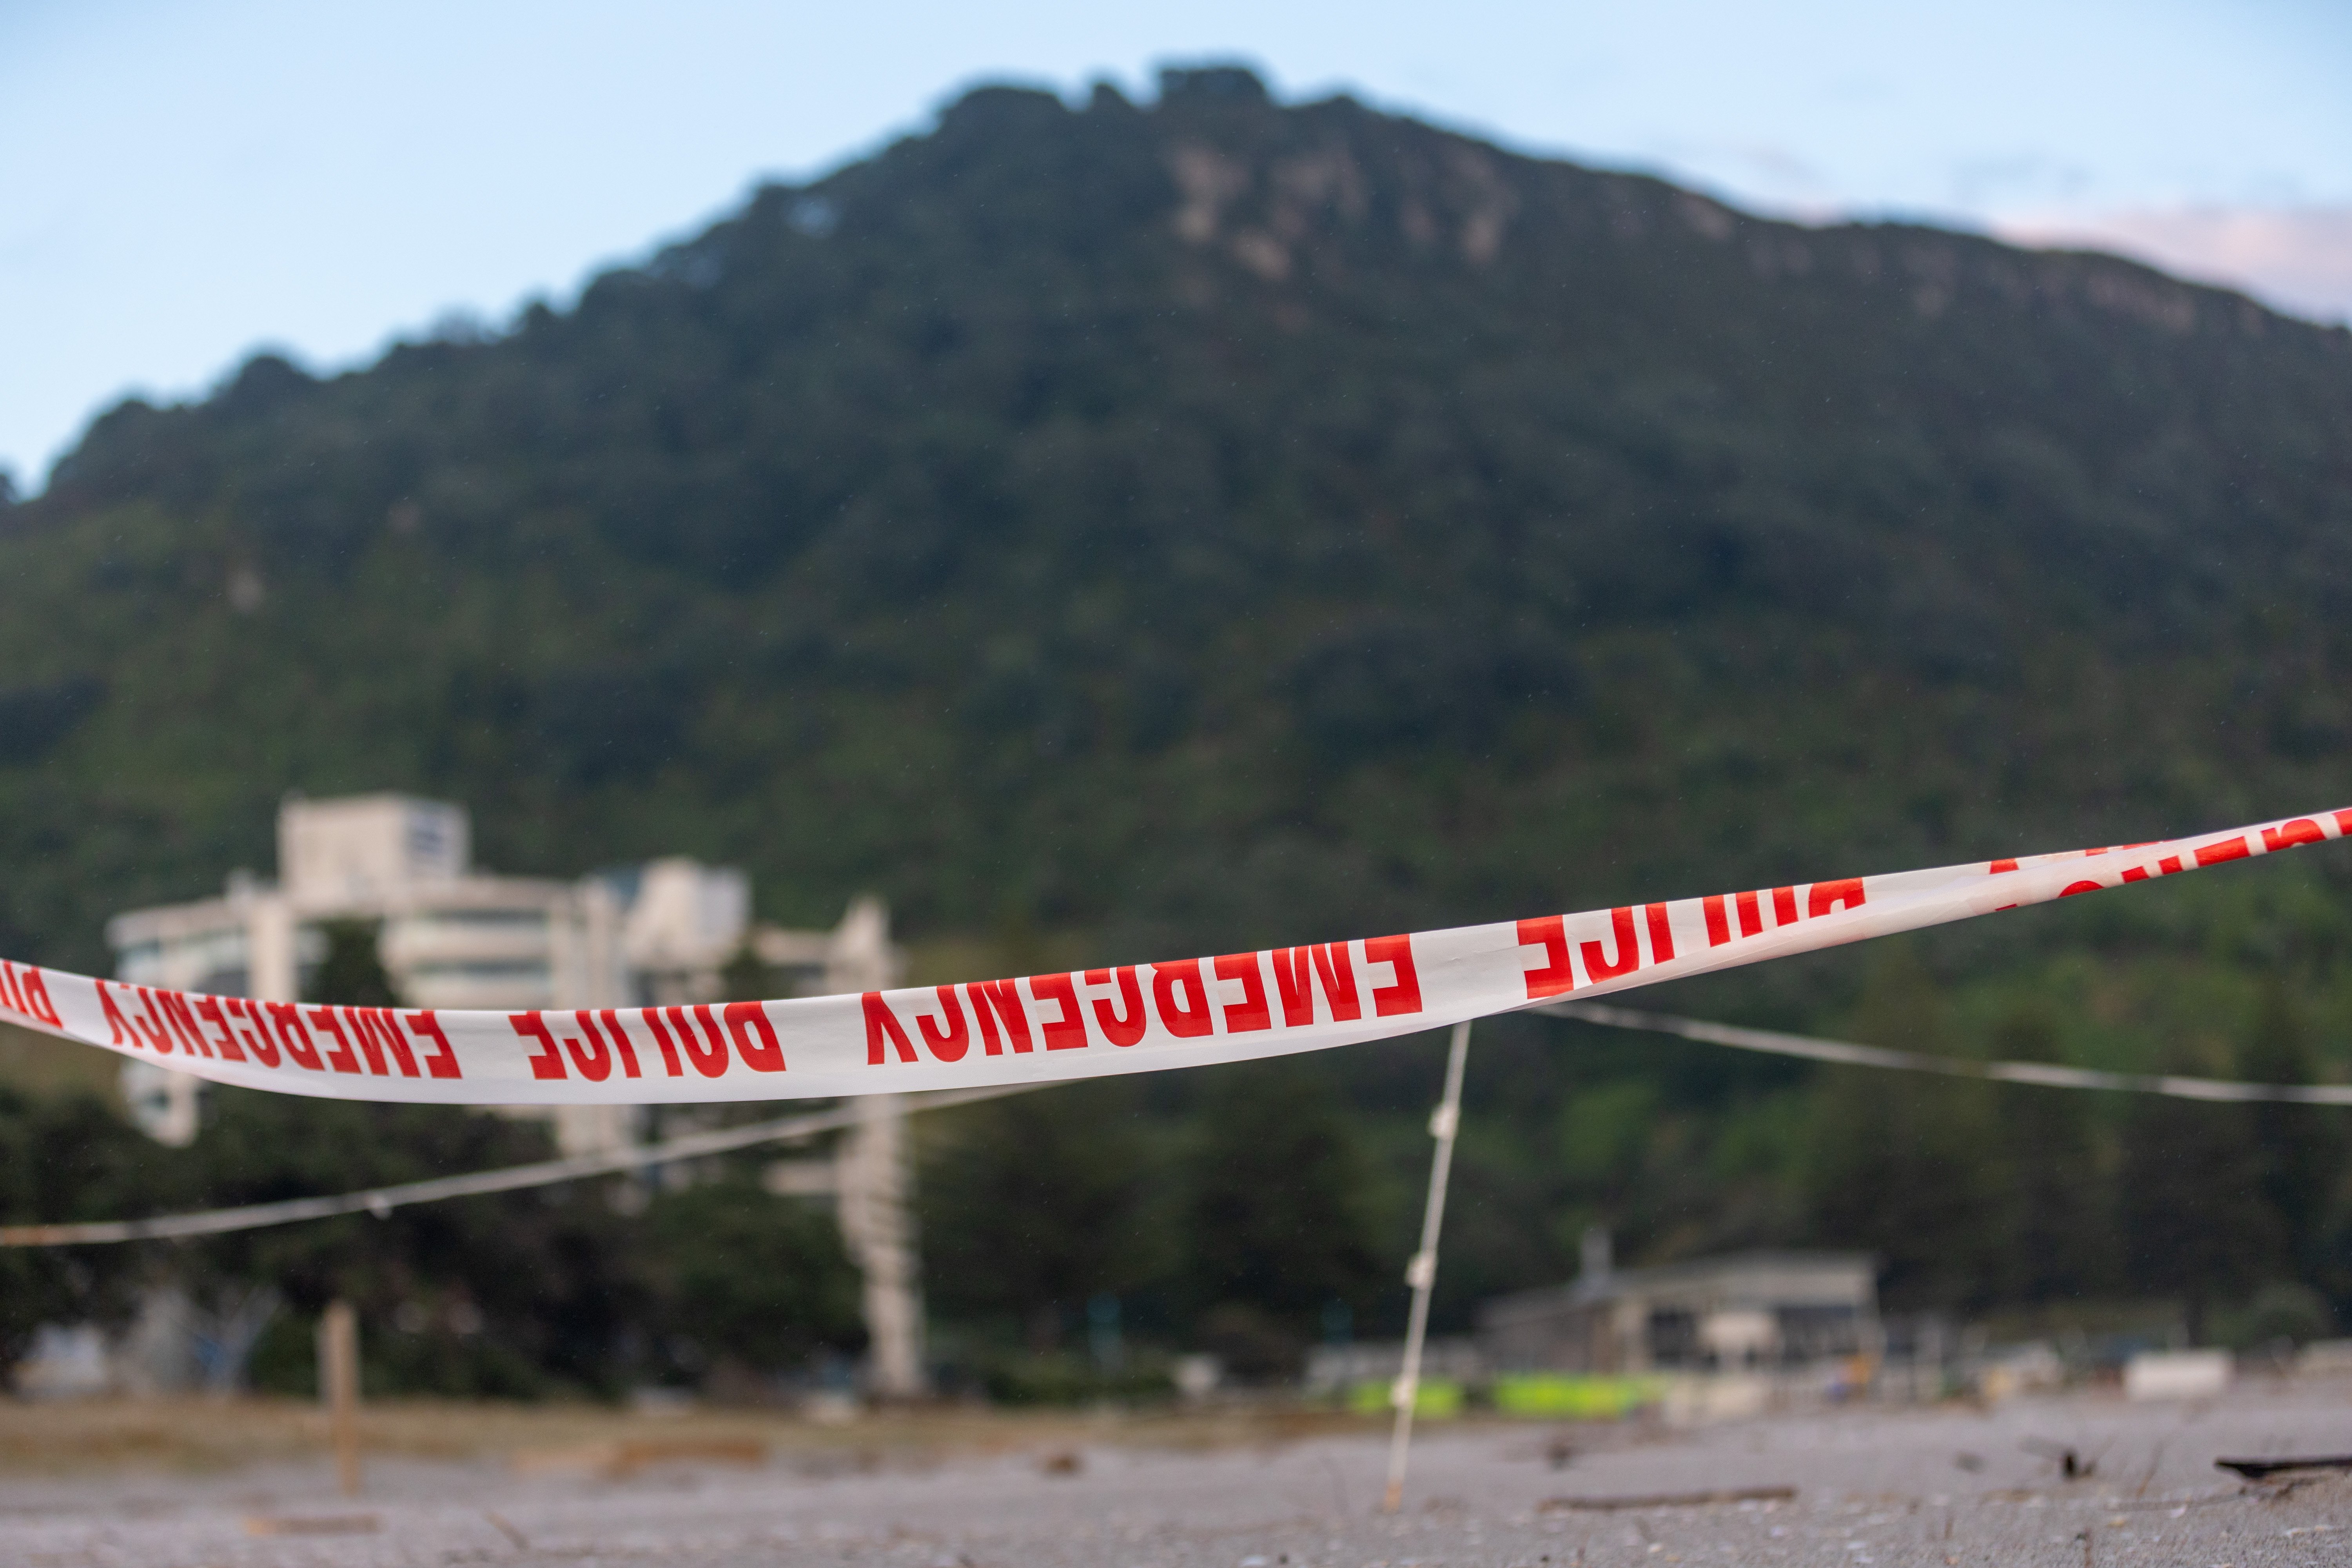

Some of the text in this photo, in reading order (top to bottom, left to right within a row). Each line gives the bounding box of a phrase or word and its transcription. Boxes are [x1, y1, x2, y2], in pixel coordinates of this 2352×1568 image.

[1516, 876, 1866, 1000] LICE
[95, 979, 462, 1079] EMERGENCY
[508, 1000, 786, 1082] POLICE
[861, 933, 1423, 1065] EMERGENCY
